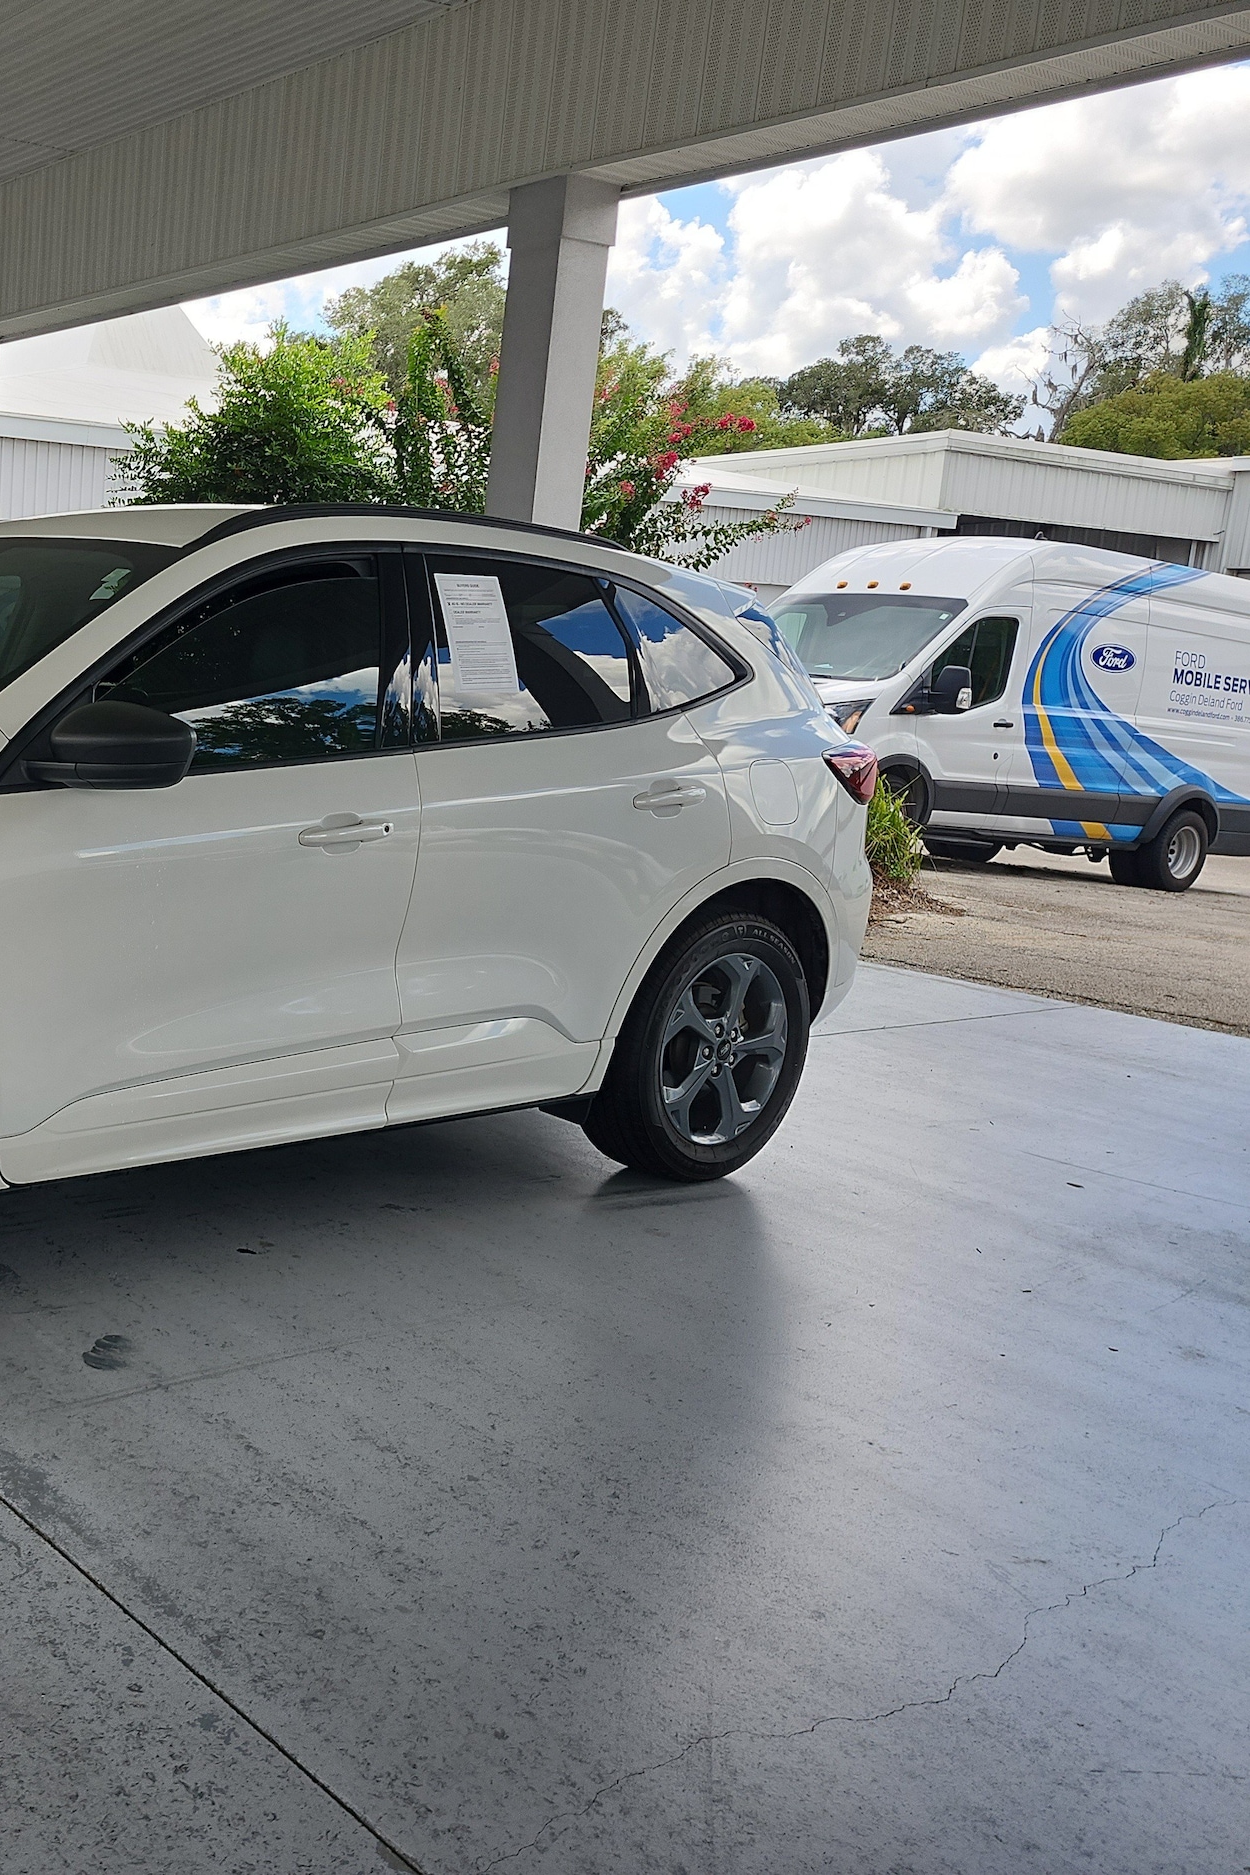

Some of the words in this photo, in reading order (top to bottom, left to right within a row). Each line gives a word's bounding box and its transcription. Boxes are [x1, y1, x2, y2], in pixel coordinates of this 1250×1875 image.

[1099, 647, 1128, 669] Ford
[1174, 650, 1206, 669] FORD
[1172, 668, 1222, 690] MOBILE
[1223, 676, 1250, 695] SER
[1169, 690, 1197, 706] Coggin
[1197, 694, 1225, 709] Deland
[1225, 698, 1244, 711] Ford
[752, 928, 768, 938] ALL
[769, 936, 797, 965] SEASON
